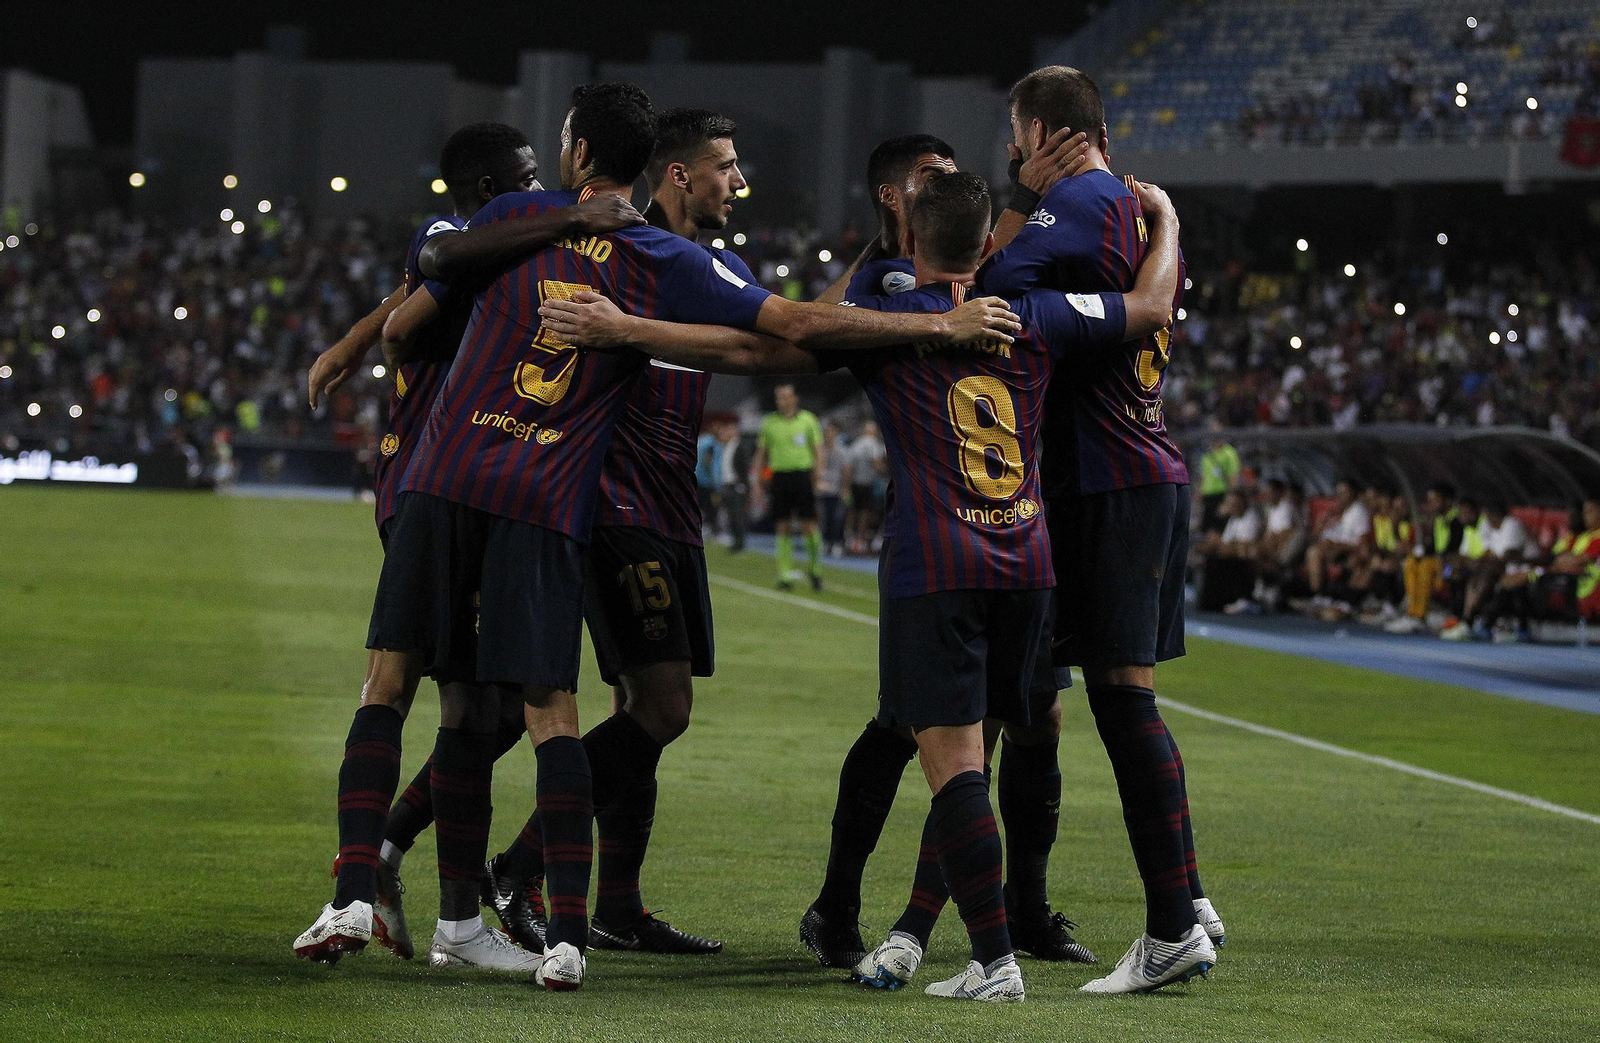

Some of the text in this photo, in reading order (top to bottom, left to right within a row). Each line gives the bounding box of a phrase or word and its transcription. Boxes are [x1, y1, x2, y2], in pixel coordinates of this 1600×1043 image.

[513, 279, 600, 406] 5
[471, 410, 538, 441] unicef
[947, 375, 1024, 499] 8
[956, 501, 1018, 525] unicef
[616, 560, 672, 615] 15
